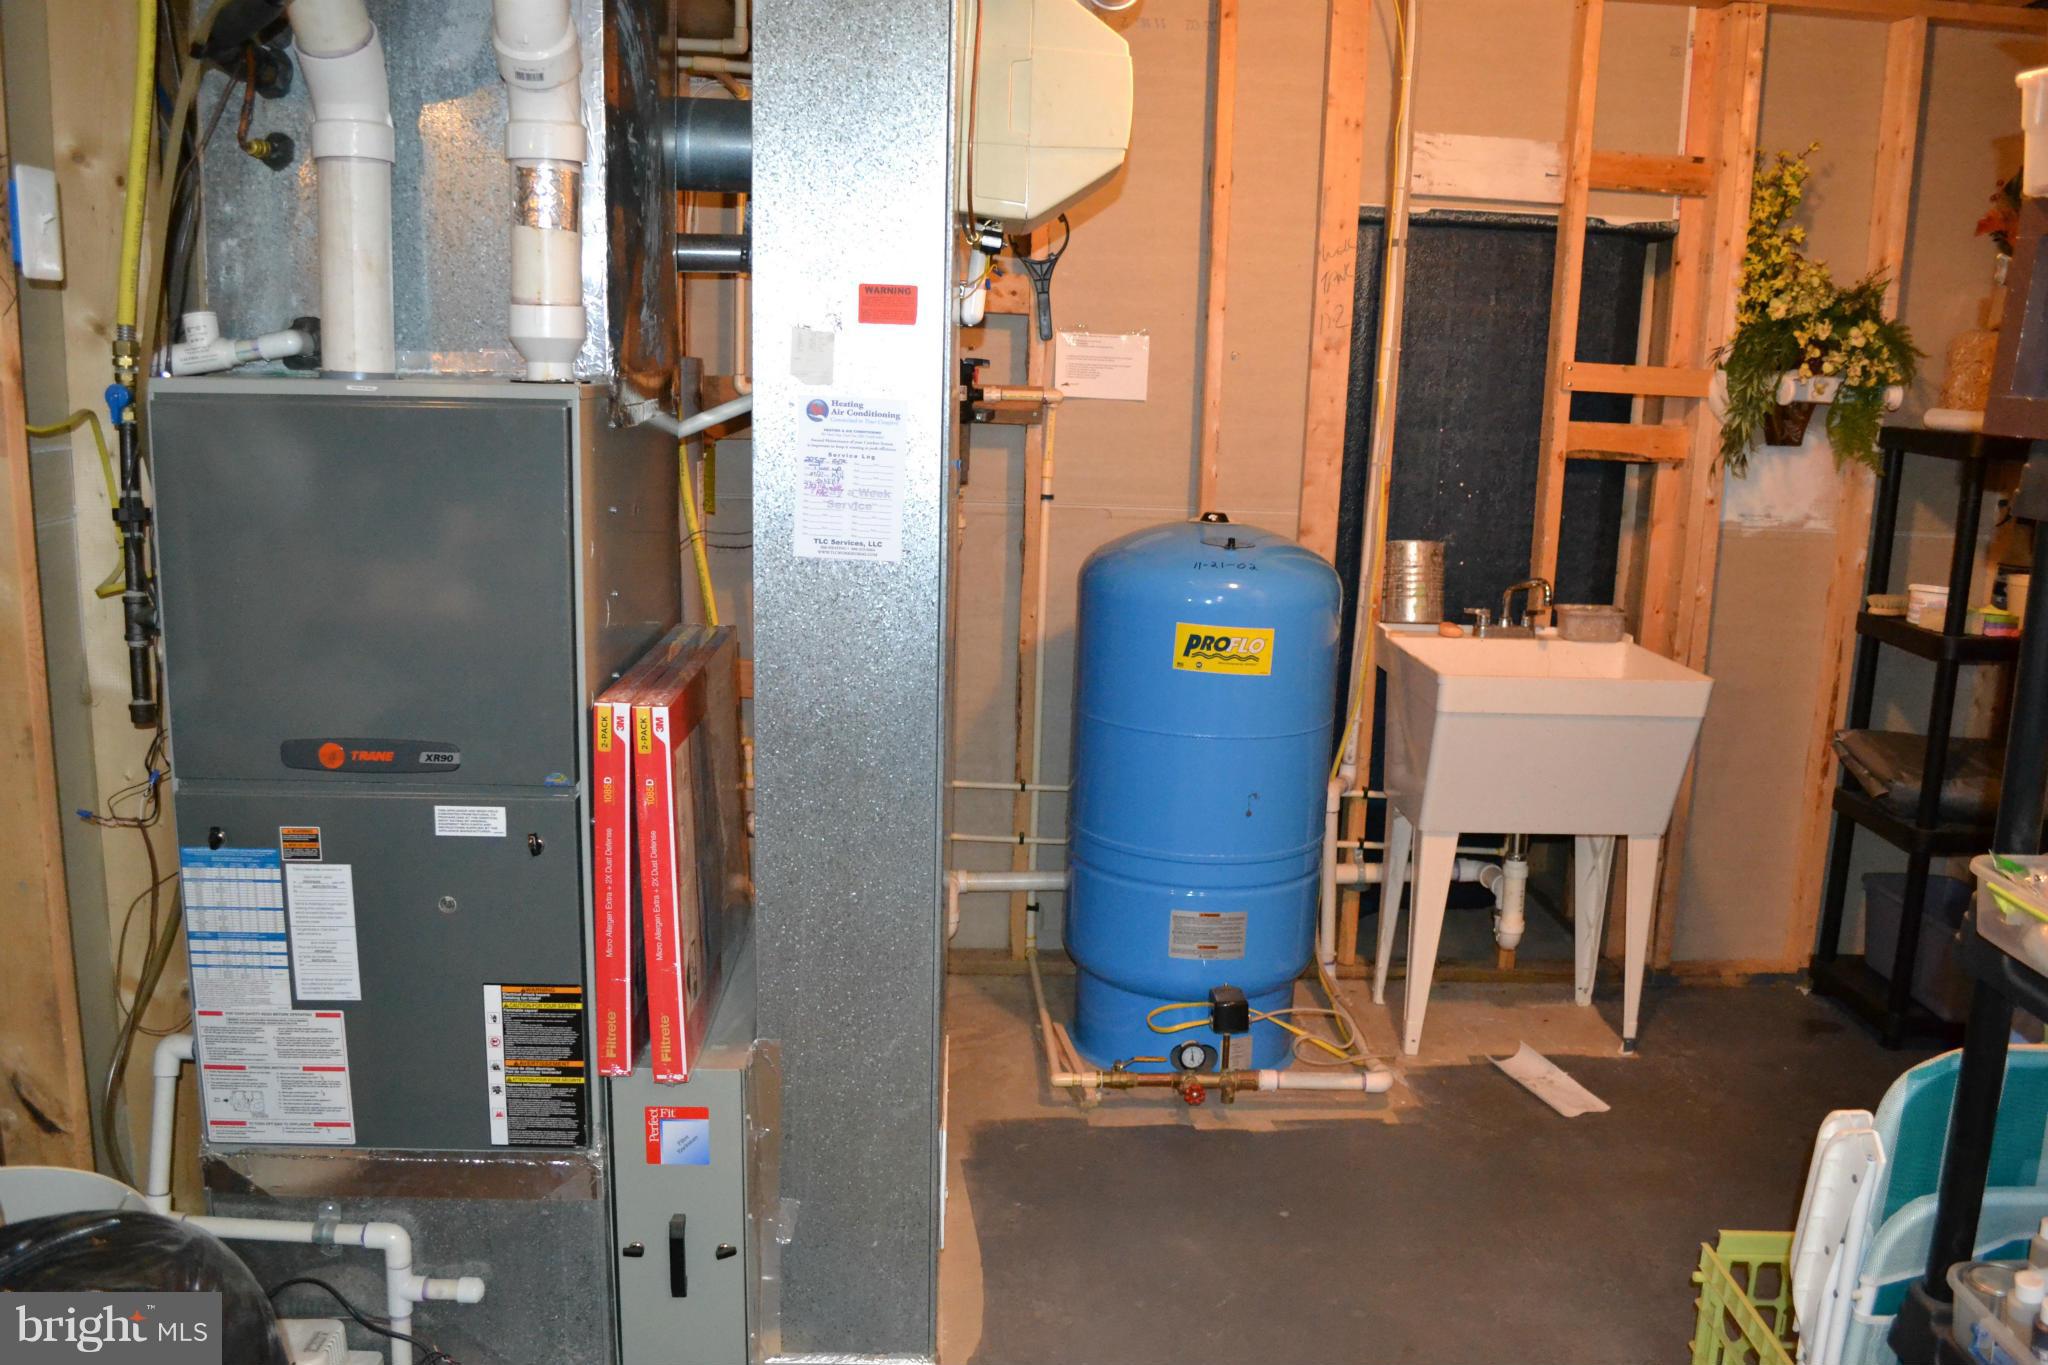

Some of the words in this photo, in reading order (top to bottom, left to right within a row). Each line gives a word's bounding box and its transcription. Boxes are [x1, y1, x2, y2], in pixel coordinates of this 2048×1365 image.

[865, 286, 911, 295] WARNING
[831, 400, 864, 409] Heating
[847, 409, 901, 420] Conditioning
[831, 539, 866, 548] Services,
[1183, 633, 1265, 657] PROFLO
[601, 715, 609, 748] 2-PACK
[616, 716, 625, 732] 3M
[655, 717, 665, 733] 3M
[641, 717, 649, 750] 2-PACK
[351, 751, 394, 762] TRANE
[424, 753, 454, 763] XR90
[605, 828, 613, 856] Defense
[650, 830, 658, 858] Defense
[605, 857, 613, 873] Dust
[651, 860, 659, 876] Dust
[605, 893, 613, 910] Extra
[652, 895, 661, 913] Extra
[605, 911, 615, 938] Allergen
[654, 914, 663, 941] Allergen
[605, 939, 613, 957] Micro
[655, 942, 663, 960] Micro
[606, 1011, 616, 1058] Filtrete
[661, 1015, 672, 1062] Filtrete
[660, 1108, 675, 1118] Fit
[648, 1109, 660, 1142] Perfect
